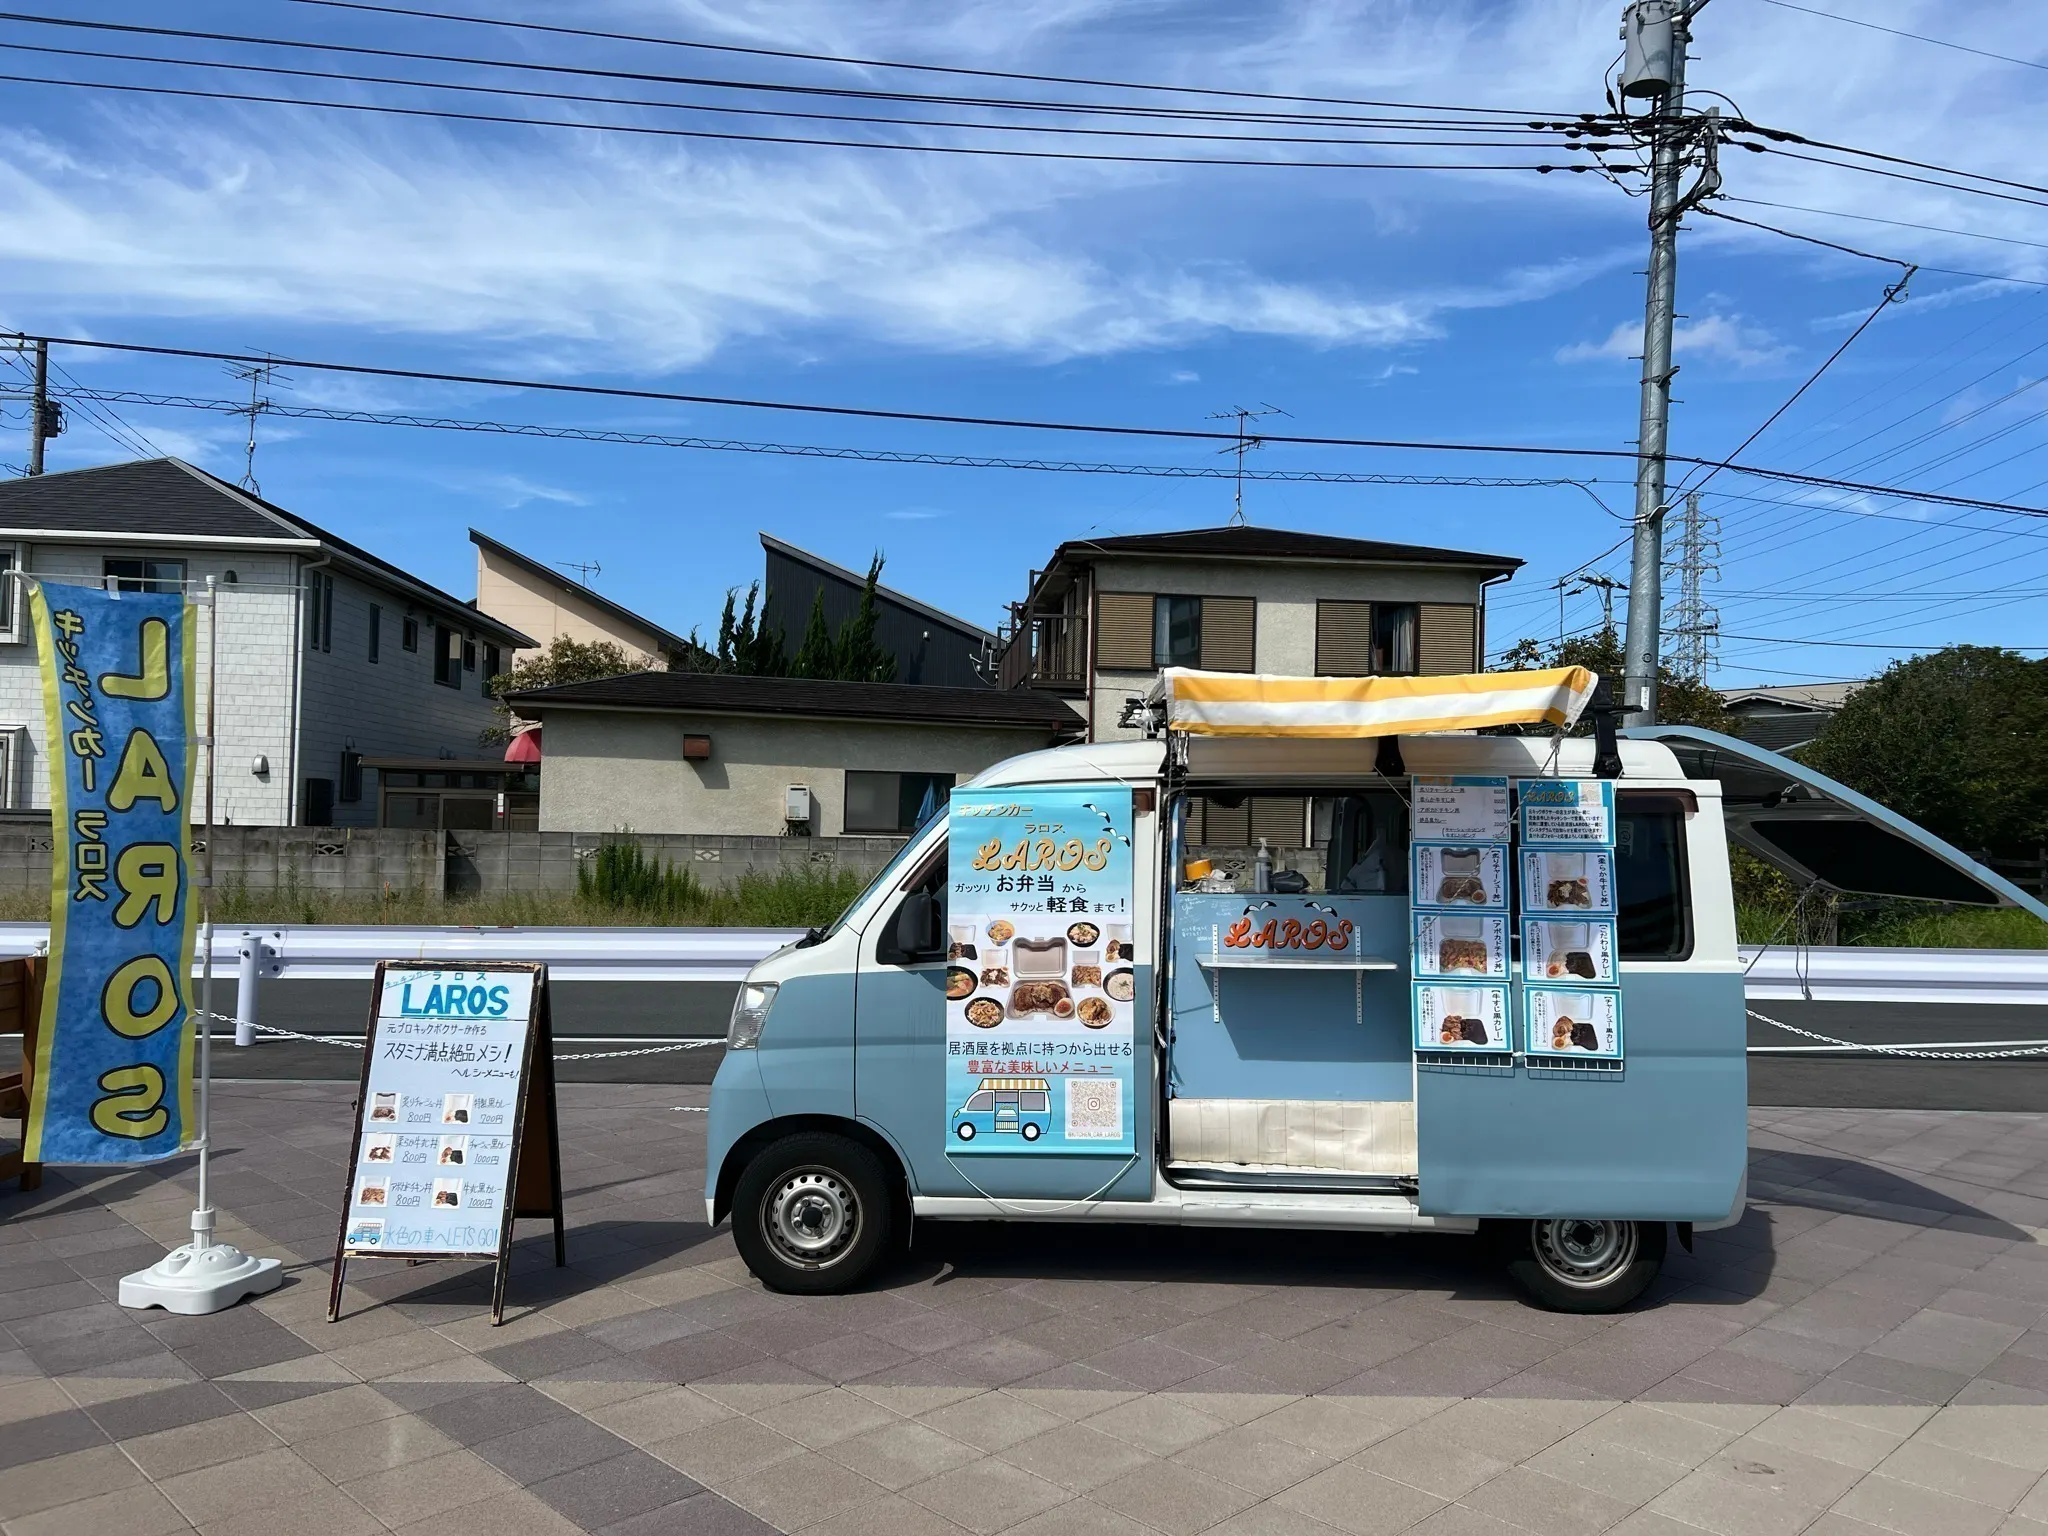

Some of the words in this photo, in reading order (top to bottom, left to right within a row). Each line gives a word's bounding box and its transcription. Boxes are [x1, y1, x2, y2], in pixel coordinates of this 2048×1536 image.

[1526, 790, 1576, 804] LAROS
[958, 803, 1033, 817] キッチンカー
[1024, 824, 1065, 834] ラロス
[971, 838, 1111, 871] LAROS
[955, 884, 990, 893] ガッツリ
[996, 874, 1055, 893] お弁当
[1062, 884, 1087, 893] から
[1010, 902, 1043, 912] サクッと
[1046, 896, 1089, 913] 軽食
[1224, 917, 1353, 950] LAROS
[400, 984, 510, 1016] LAROS
[948, 1041, 1132, 1056] 居酒屋を拠点に持つから出せる
[967, 1060, 1114, 1074] 豊富な美味しいメニュー
[407, 1112, 432, 1122] 800円
[480, 1114, 504, 1124] 700円
[403, 1151, 427, 1162] 800円
[474, 1153, 500, 1164] 1000円
[396, 1194, 421, 1206] 800円
[468, 1198, 494, 1208] 1000円
